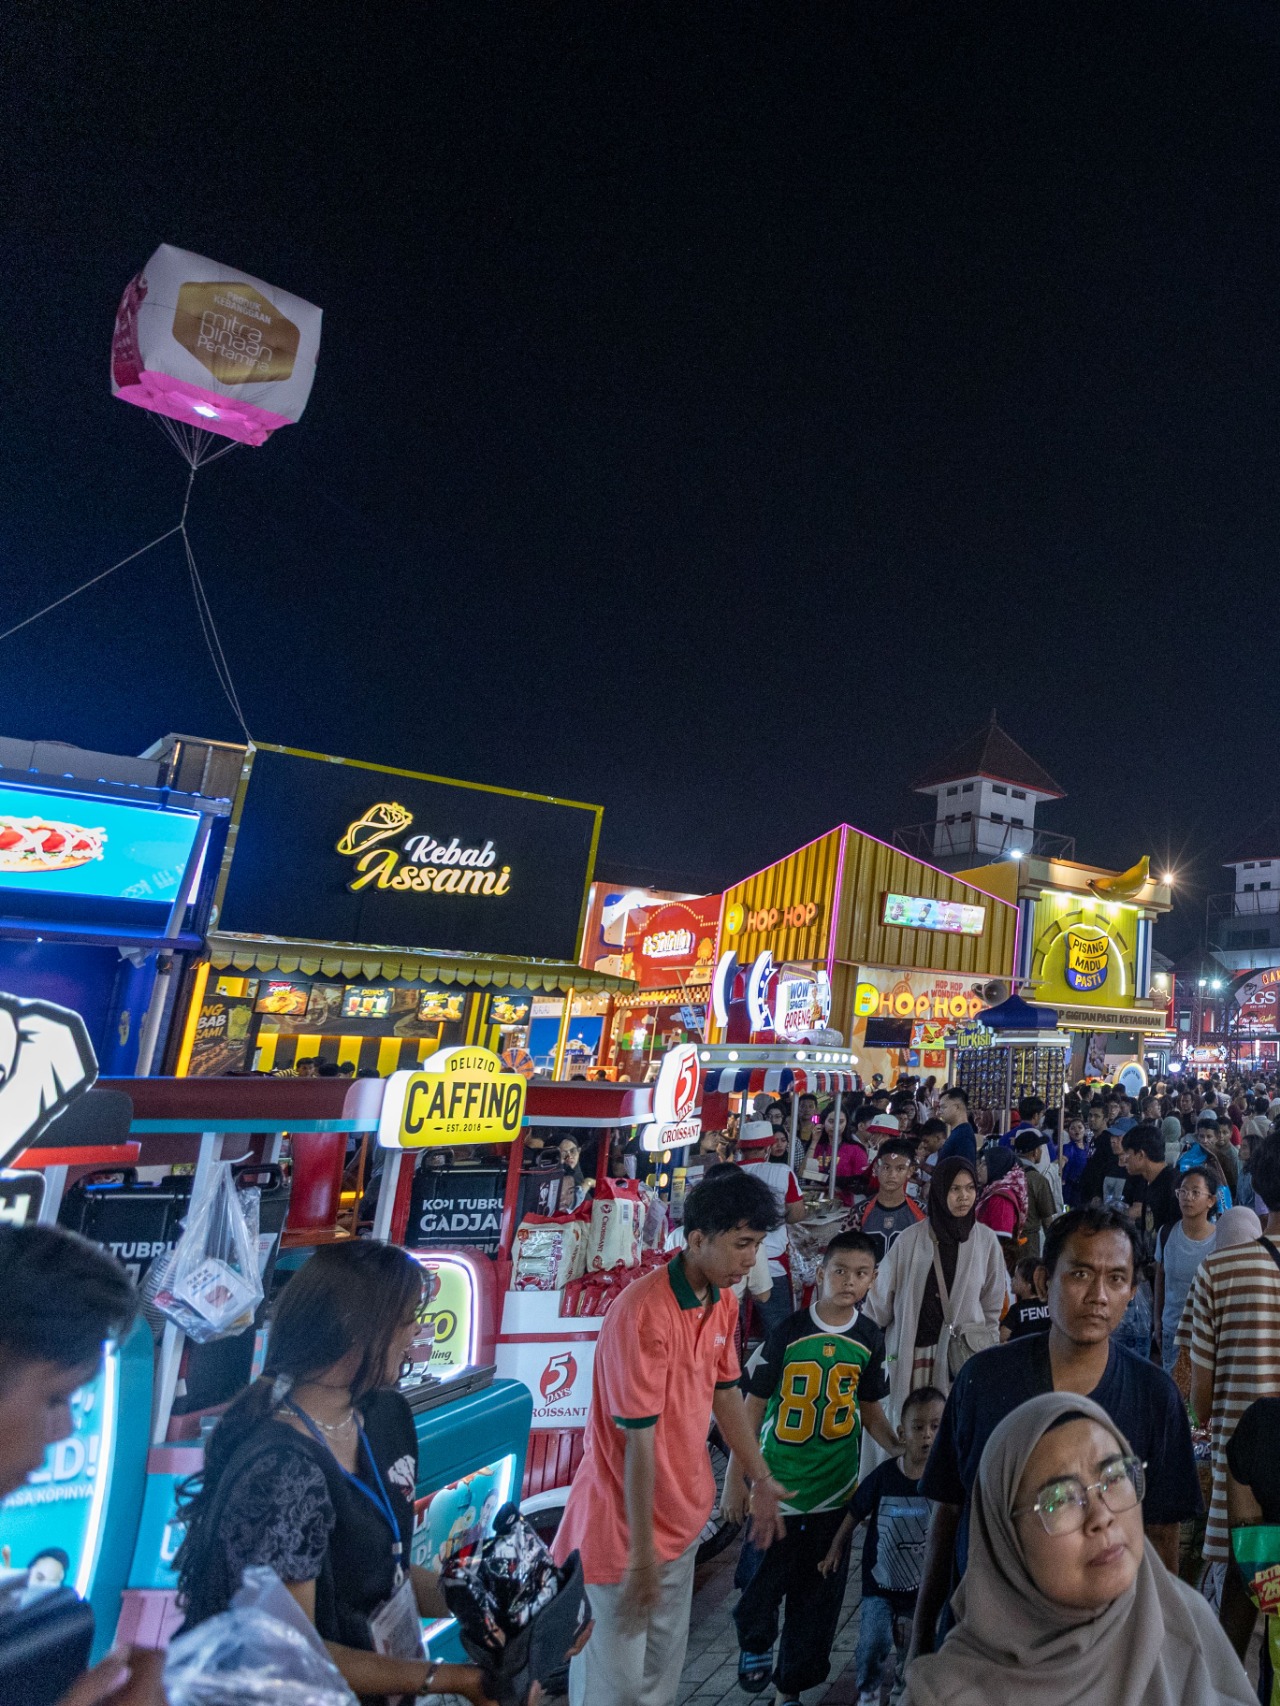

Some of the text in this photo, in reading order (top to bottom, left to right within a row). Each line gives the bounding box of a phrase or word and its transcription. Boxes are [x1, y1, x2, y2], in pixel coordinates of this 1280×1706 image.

[202, 310, 262, 343] mitra
[200, 321, 273, 361] binaan
[197, 337, 270, 372] Pertamina
[403, 834, 497, 868] Kebab
[349, 848, 512, 896] Assami
[747, 901, 818, 933] HOP HOP
[1072, 938, 1104, 955] PISANG
[1075, 956, 1101, 972] MADU
[790, 981, 809, 999] WOW
[879, 992, 983, 1019] HOP HOP
[197, 1014, 227, 1029] BAB
[784, 1009, 811, 1030] GORENG
[1066, 1010, 1097, 1021] GIGITAN
[1097, 1014, 1118, 1023] PASTI
[1119, 1014, 1161, 1026] KETAGIHAN
[450, 1057, 496, 1074] DELIZIO
[677, 1054, 696, 1109] 5
[464, 1122, 481, 1133] 2018
[661, 1124, 701, 1145] CROISSANT
[419, 1212, 503, 1232] GADJA
[545, 1353, 573, 1398] 5
[545, 1388, 572, 1407] DAYS
[774, 1360, 862, 1444] 88
[531, 1407, 588, 1418] ROISSANT
